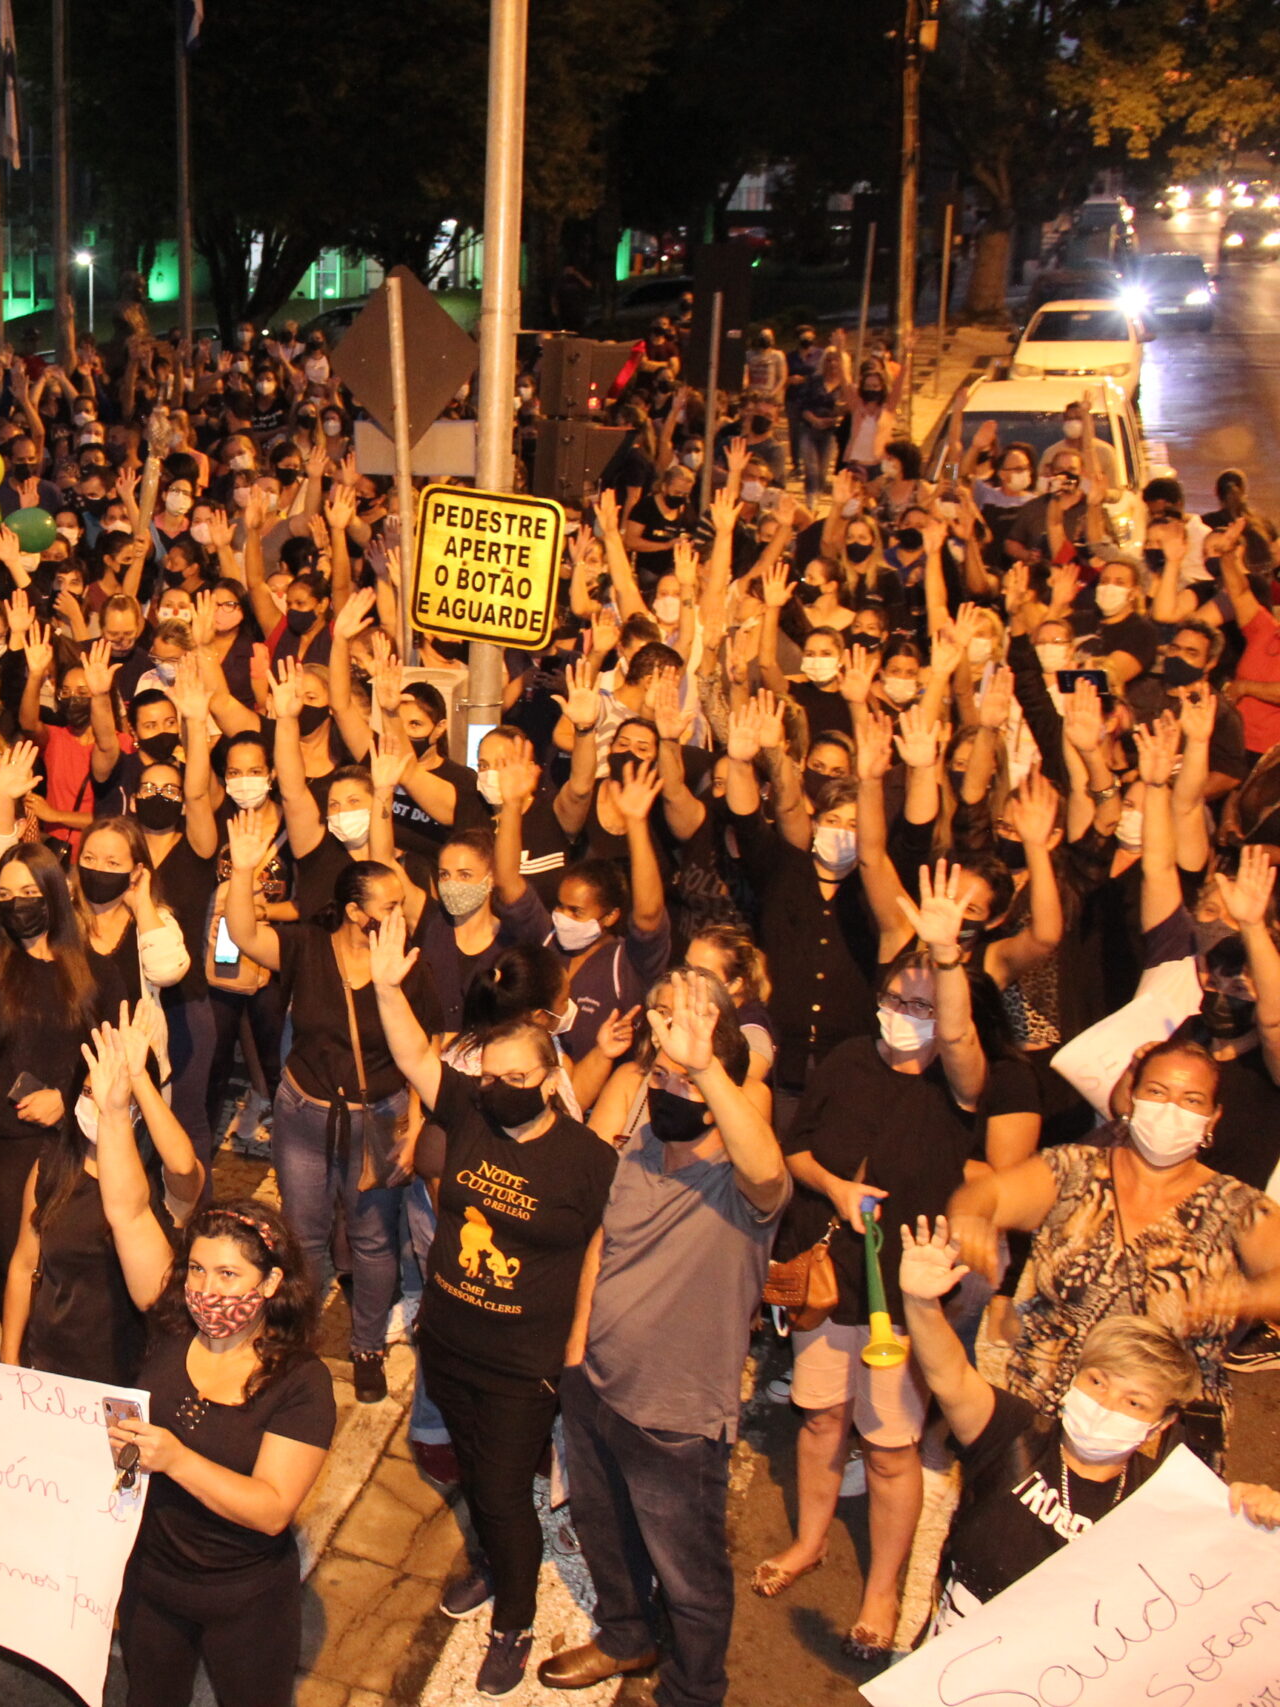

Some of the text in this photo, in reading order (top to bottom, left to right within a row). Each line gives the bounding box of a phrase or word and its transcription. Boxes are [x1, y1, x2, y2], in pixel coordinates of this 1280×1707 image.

[433, 503, 547, 540] PEDESTRE
[444, 536, 531, 568] APERTE
[434, 564, 532, 600] O BOTÃO
[417, 592, 543, 632] E AGUARDE
[456, 1169, 539, 1211] CULTURAL
[483, 1197, 531, 1221] O REI LEÃO
[459, 1280, 486, 1298] CMEI
[483, 1300, 523, 1315] CLERIS
[7, 1371, 107, 1428] Ribei
[66, 1575, 114, 1630] part
